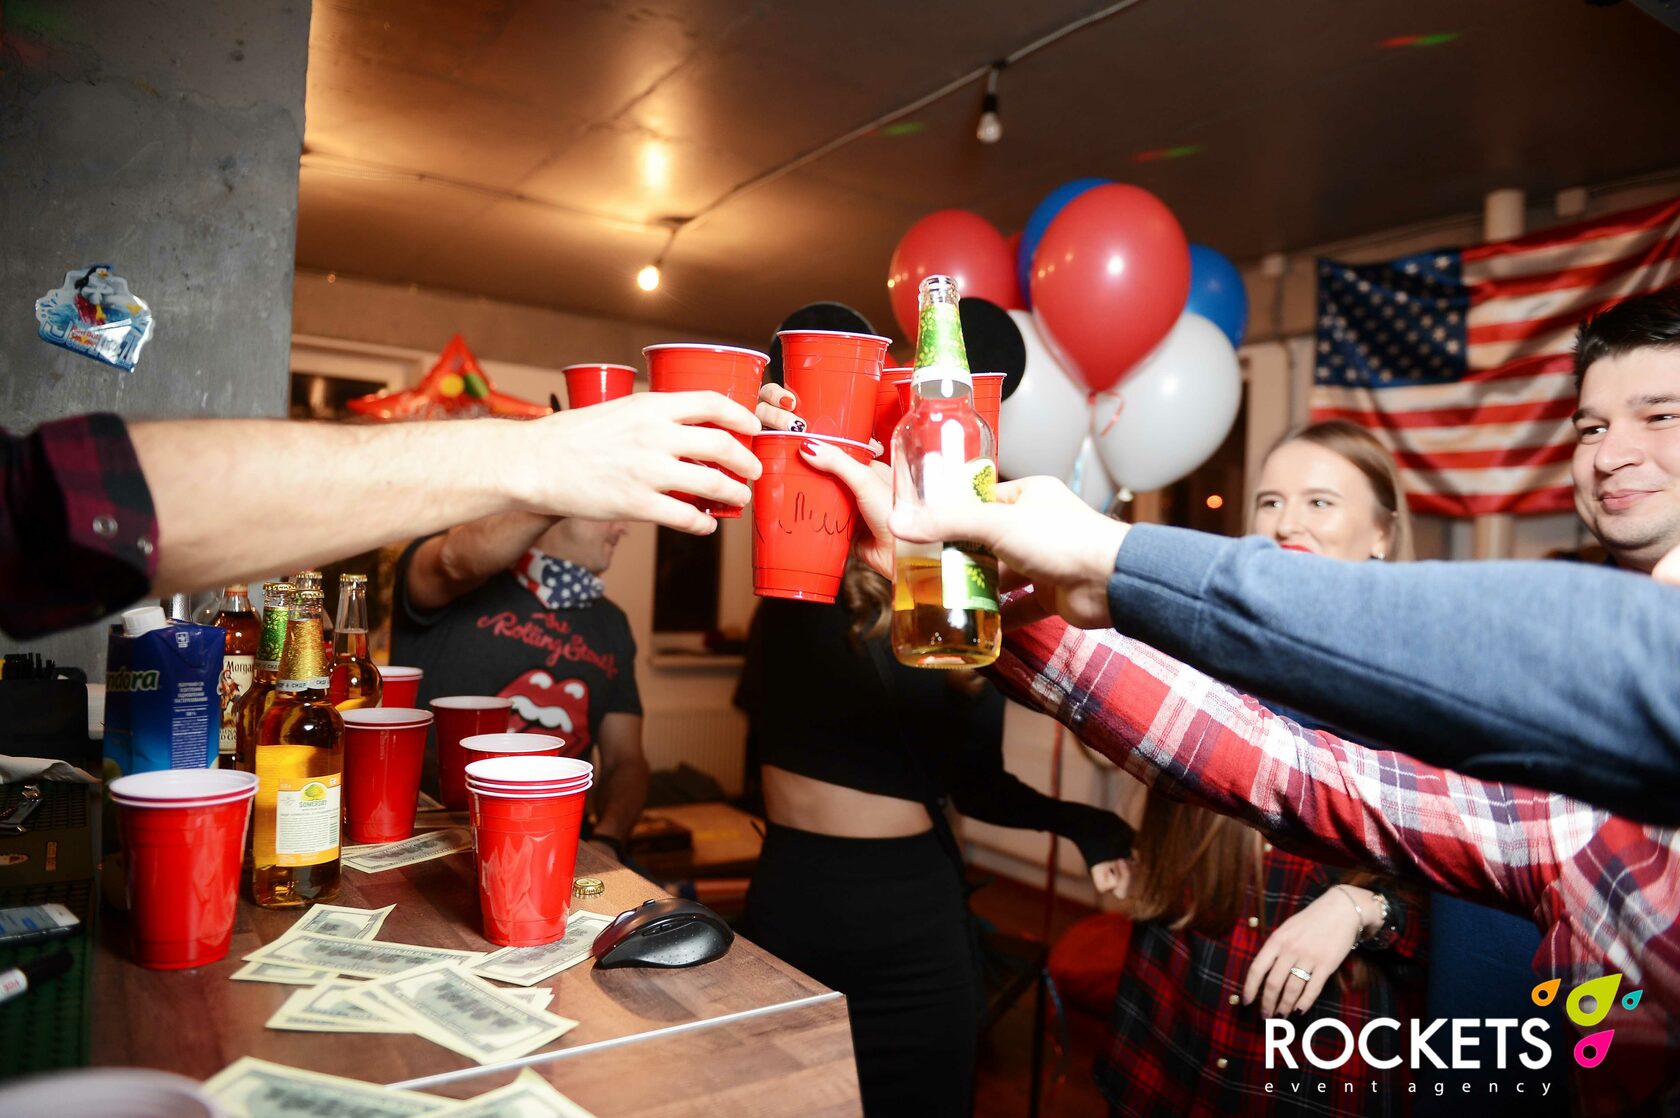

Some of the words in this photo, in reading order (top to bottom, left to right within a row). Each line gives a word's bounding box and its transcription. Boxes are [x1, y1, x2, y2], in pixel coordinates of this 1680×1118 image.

[476, 611, 563, 667] Rolling
[106, 667, 160, 691] ndora
[226, 660, 253, 674] Morga
